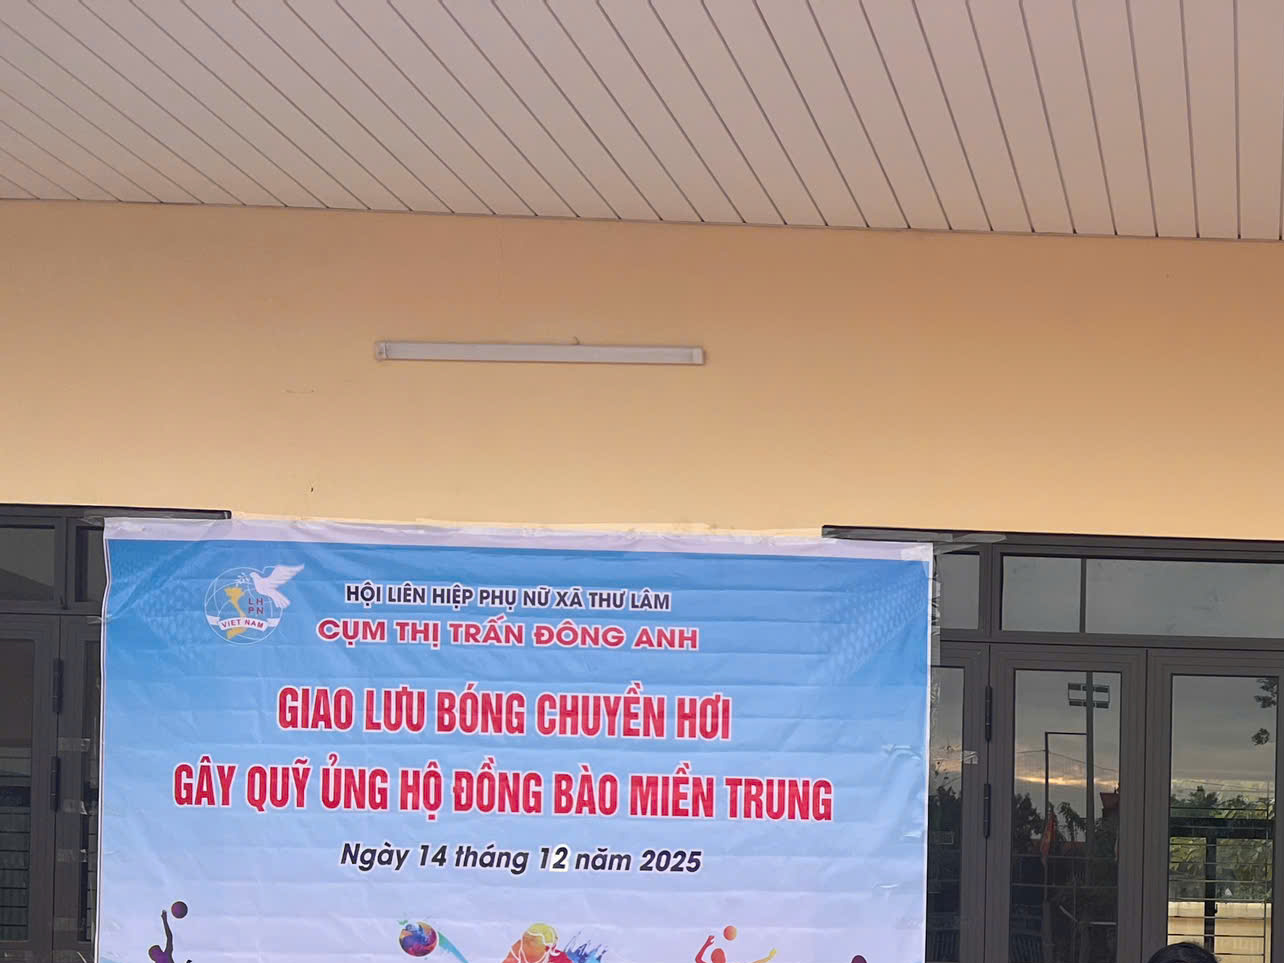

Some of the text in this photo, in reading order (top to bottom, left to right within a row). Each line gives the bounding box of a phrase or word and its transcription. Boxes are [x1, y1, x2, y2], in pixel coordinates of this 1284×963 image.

[346, 581, 670, 611] HỘI LIÊN HIỆP PHỤ NỮ XÃ THƯ LÂM
[244, 619, 265, 629] NAM
[317, 613, 698, 649] CỤM THỊ TRẤN ĐÔNG ANH
[278, 681, 731, 740] GIAO LƯU BÓNG CHUYỀN HƠI
[173, 752, 833, 822] GÂY QUỸ ỦNG HỘ ĐỒNG BÀO MIỀN TRUNG
[340, 841, 703, 875] Ngày 14 tháng 12 năm 2025
